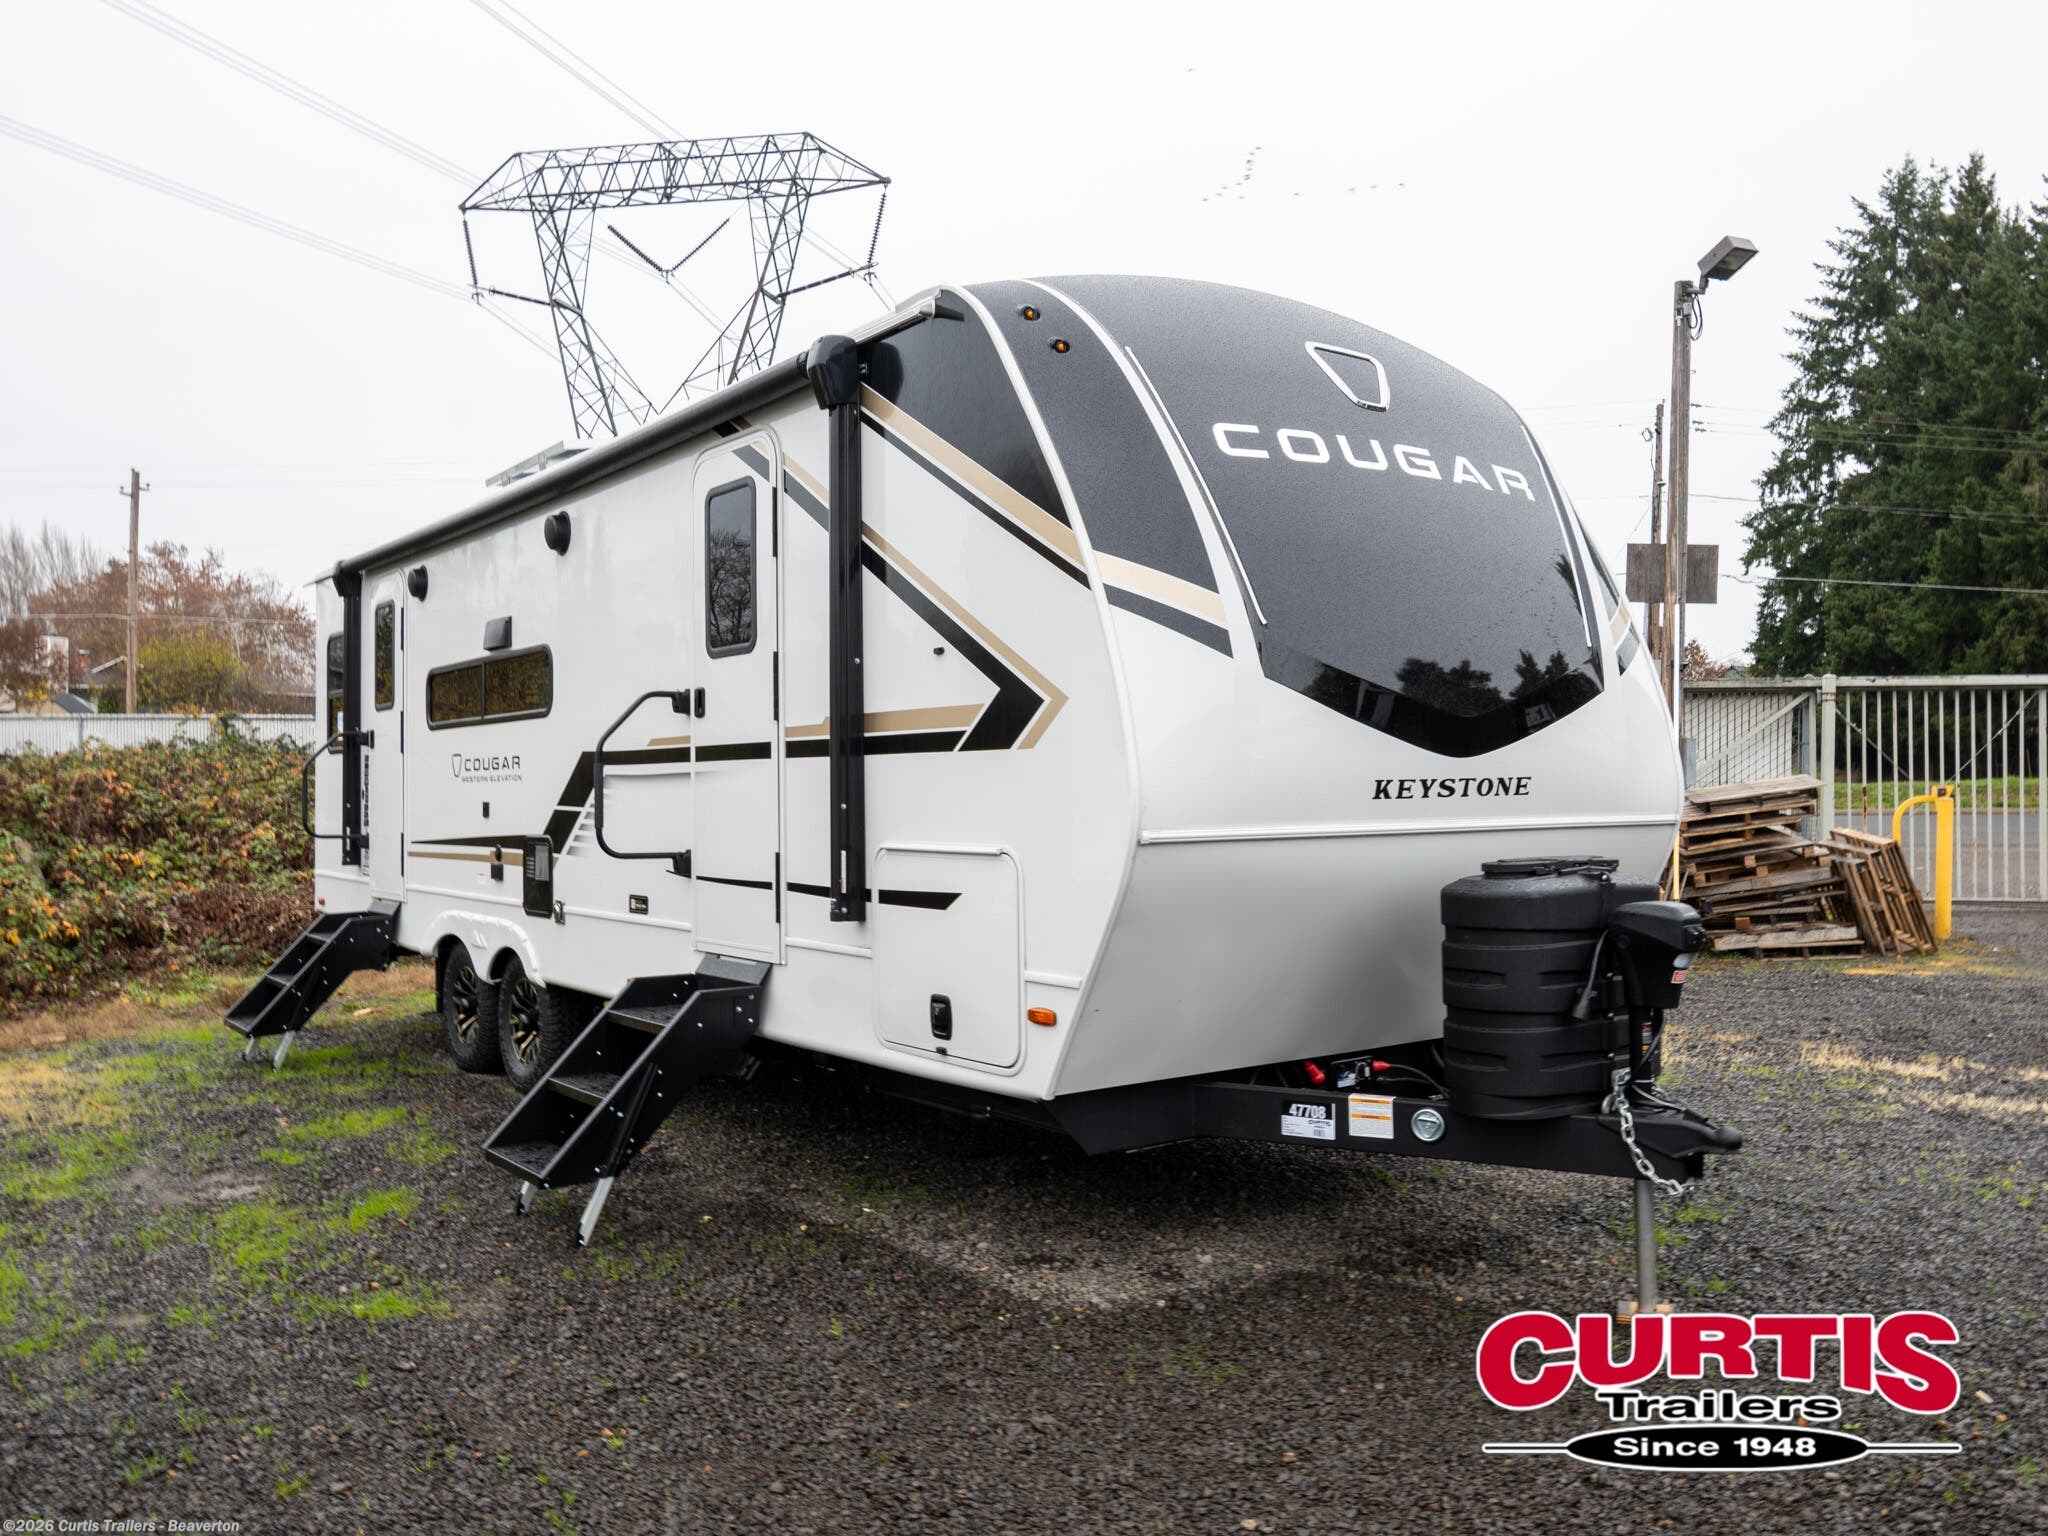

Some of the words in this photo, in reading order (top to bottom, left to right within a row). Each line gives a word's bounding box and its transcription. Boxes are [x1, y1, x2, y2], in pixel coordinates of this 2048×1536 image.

[1211, 422, 1536, 502] COUGAR
[464, 755, 521, 772] COUGAR
[461, 775, 489, 783] WESTERN
[490, 773, 523, 782] ELEVATION
[1371, 776, 1532, 800] KEYSTONE
[1288, 1103, 1327, 1119] 47708
